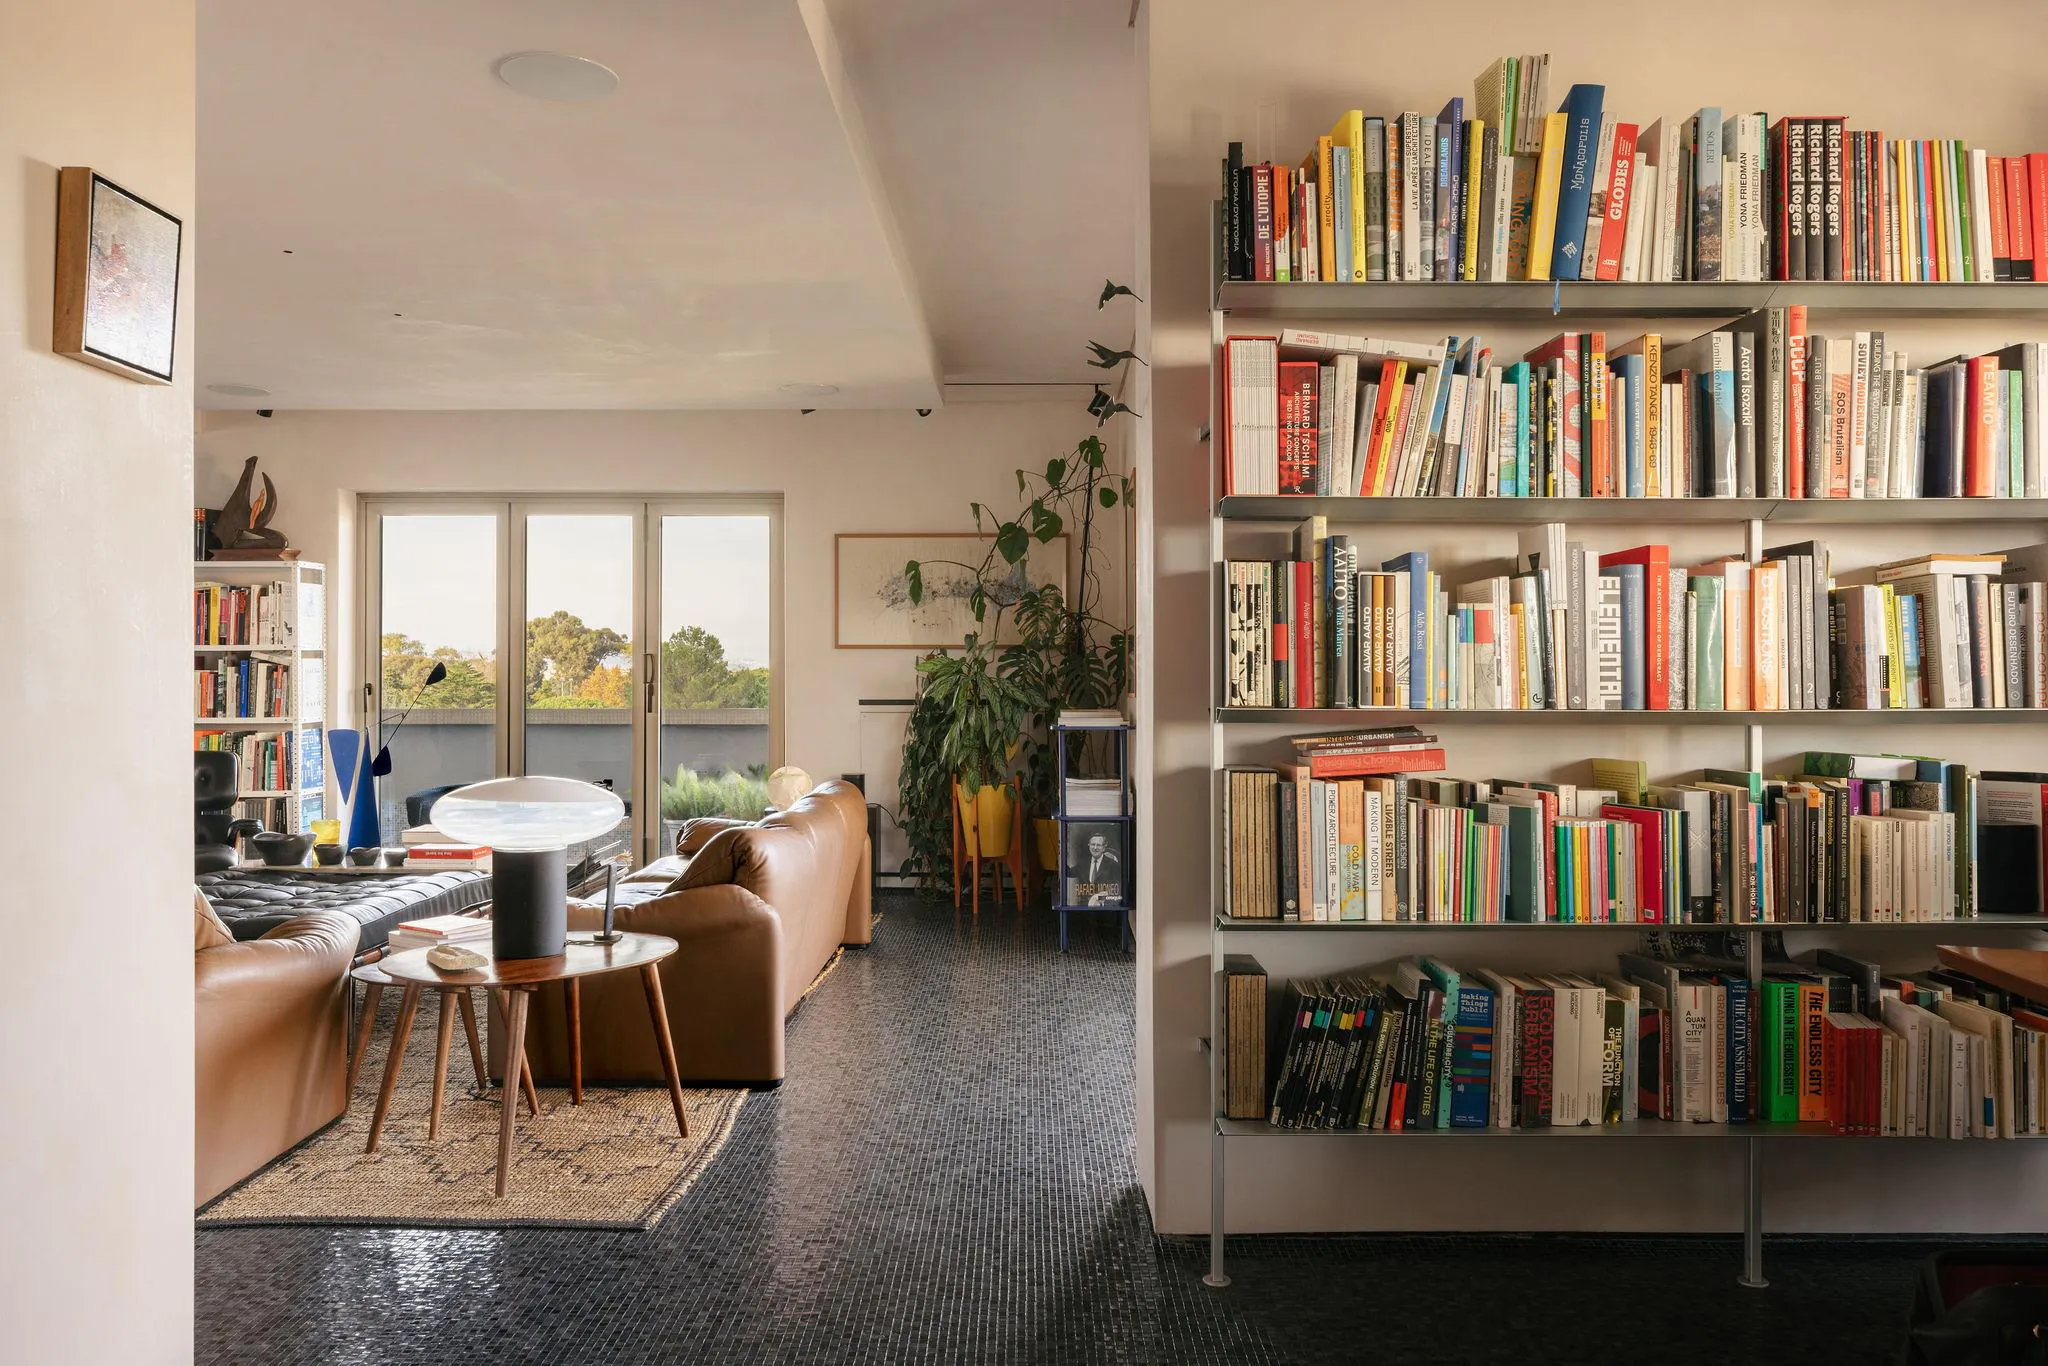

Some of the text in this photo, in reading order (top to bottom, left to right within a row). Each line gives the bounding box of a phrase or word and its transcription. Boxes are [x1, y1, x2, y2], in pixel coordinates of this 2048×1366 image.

[1440, 138, 1448, 188] DREAMLANDS
[1706, 130, 1715, 164] SOLERI
[1739, 152, 1747, 200] FRIEDMAN
[1258, 176, 1270, 222] L'UTOPIE
[1411, 200, 1418, 210] LA
[1609, 159, 1629, 220] GLOBES
[1788, 124, 1805, 236] Richard Rogers
[1807, 124, 1823, 236] Richard Rogers
[1826, 124, 1842, 236] Richard Rogers
[1258, 227, 1270, 239] DE
[1324, 195, 1332, 228] aerocity
[1928, 258, 1935, 266] 6
[1964, 256, 1970, 264] 2
[1713, 336, 1722, 406] Fumihiko Maki
[1741, 346, 1753, 426] Arata Isozaki
[1789, 335, 1806, 382] CCCP
[1814, 356, 1822, 412] ARCHI BRUT
[1871, 338, 1882, 432] BUILDING THE REVOLUTION
[1649, 344, 1658, 468] KENZO TANGE 1946-69
[1983, 361, 1996, 425] TEAM 10
[1302, 383, 1310, 478] BERNARD TSCHUMI
[1836, 391, 1846, 465] SOS Brutalism
[1334, 546, 1347, 600] AALTO
[1303, 601, 1311, 619] Alvar
[1336, 605, 1344, 657] Villa Mairea
[1416, 609, 1424, 650] Aldo Rossi
[1571, 589, 1579, 622] COMPLETE
[1977, 595, 1985, 625] ALDO
[1363, 606, 1371, 673] ALVAR AALTO
[1374, 606, 1382, 673] ALVAR AALTO
[1386, 606, 1394, 673] ALVAR AALTO
[1599, 576, 1622, 709] ELEMENTAL
[1656, 634, 1662, 643] OF
[1889, 652, 1897, 684] MODERNITY
[1980, 650, 1988, 677] EYCK
[2007, 591, 2019, 684] FUTURO DESENHADO
[1807, 683, 1814, 694] 2
[1358, 733, 1394, 741] URBANISM
[1329, 789, 1337, 877] POWER/ARCHITECTURE
[1370, 797, 1378, 886] MAKING IT MODERN
[1385, 804, 1393, 878] LIVABLE STREETS
[1352, 871, 1360, 893] WAR
[1461, 993, 1489, 1002] Making
[1461, 1000, 1489, 1008] Things
[1461, 1006, 1488, 1014] Public
[1369, 1017, 1389, 1090] CITIES, DESIGN EVOLUTION
[1383, 1013, 1403, 1088] The Policing of Families
[1421, 1018, 1439, 1116] IN THE LIFE OF CITIES
[1523, 996, 1539, 1095] URBANISM
[1538, 996, 1553, 1116] ECOLOGICAL
[1603, 1027, 1615, 1087] OF FORM
[1717, 993, 1725, 1105] GRAND URBAN RULES
[1734, 997, 1746, 1102] THE CITY ASSEMBLED
[1784, 987, 1794, 1096] LIVING IN THE ENDLESS CITY
[1809, 991, 1824, 1097] THE ENDLESS CITY
